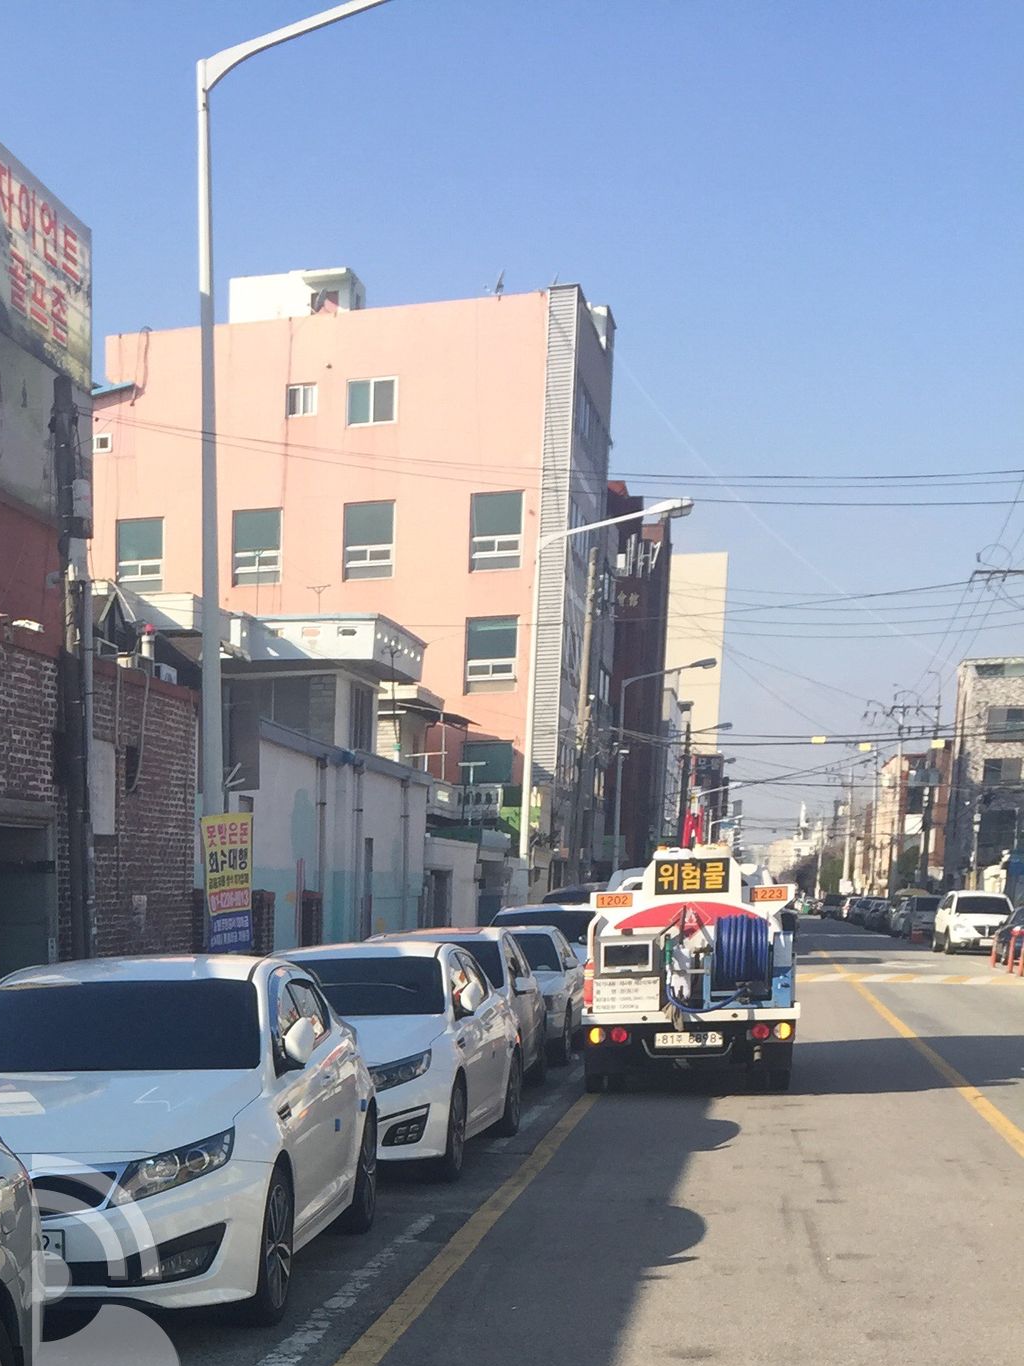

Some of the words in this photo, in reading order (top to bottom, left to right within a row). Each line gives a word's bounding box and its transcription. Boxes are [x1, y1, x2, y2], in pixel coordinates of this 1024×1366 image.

[8, 250, 67, 345] 골프존
[658, 861, 725, 891] 위험물
[600, 895, 628, 906] 1202
[752, 888, 783, 899] 1223
